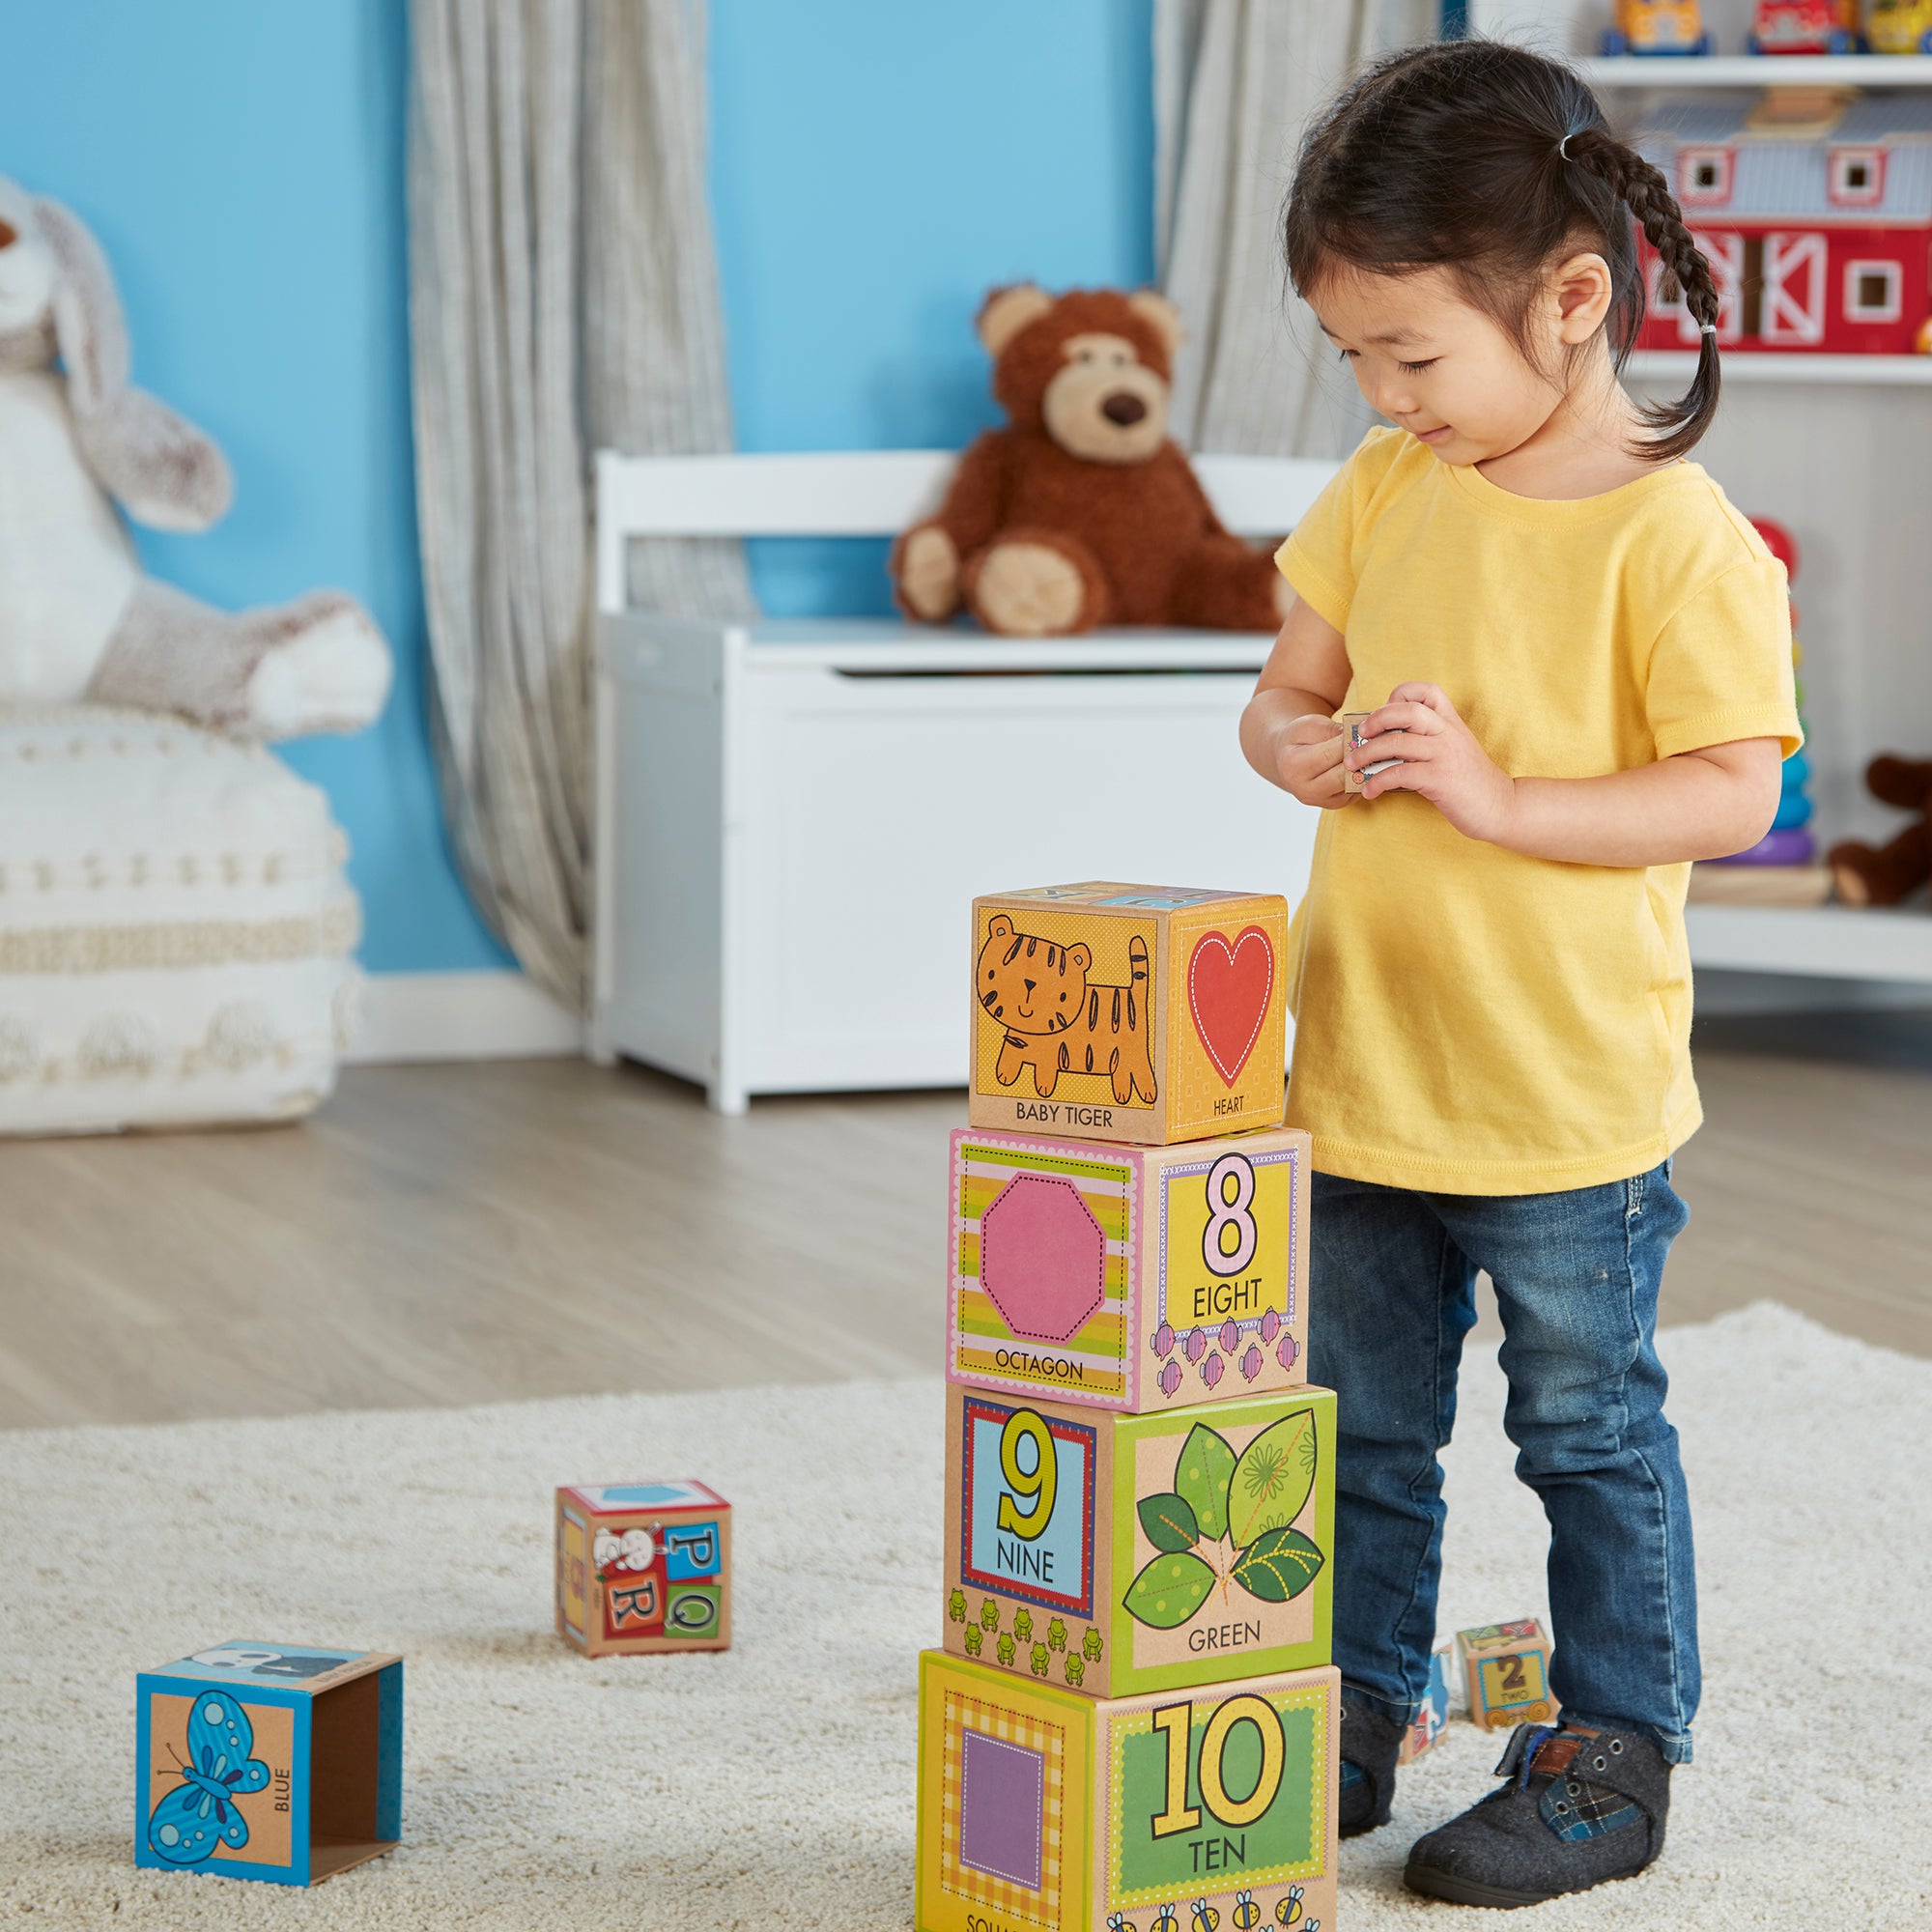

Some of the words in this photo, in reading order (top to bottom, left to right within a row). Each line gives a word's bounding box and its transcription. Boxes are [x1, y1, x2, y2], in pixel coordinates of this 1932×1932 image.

[1016, 1102, 1061, 1122] BABY
[1065, 1106, 1113, 1128] TIGER
[1213, 1095, 1245, 1116] HEART
[1202, 1151, 1258, 1278] 8
[1194, 1278, 1262, 1318] EIGHT
[995, 1349, 1084, 1380] OCTAGON
[996, 1406, 1059, 1542] 9
[669, 1528, 714, 1569] P
[997, 1537, 1054, 1584] NINE
[610, 1579, 656, 1630] R
[666, 1591, 718, 1633] Q
[1188, 1620, 1261, 1653] GREEN
[1497, 1654, 1526, 1690] 2
[1501, 1690, 1530, 1704] TWO
[1151, 1692, 1286, 1841] 10
[274, 1769, 290, 1812] BLUE
[1188, 1834, 1246, 1873] TEN
